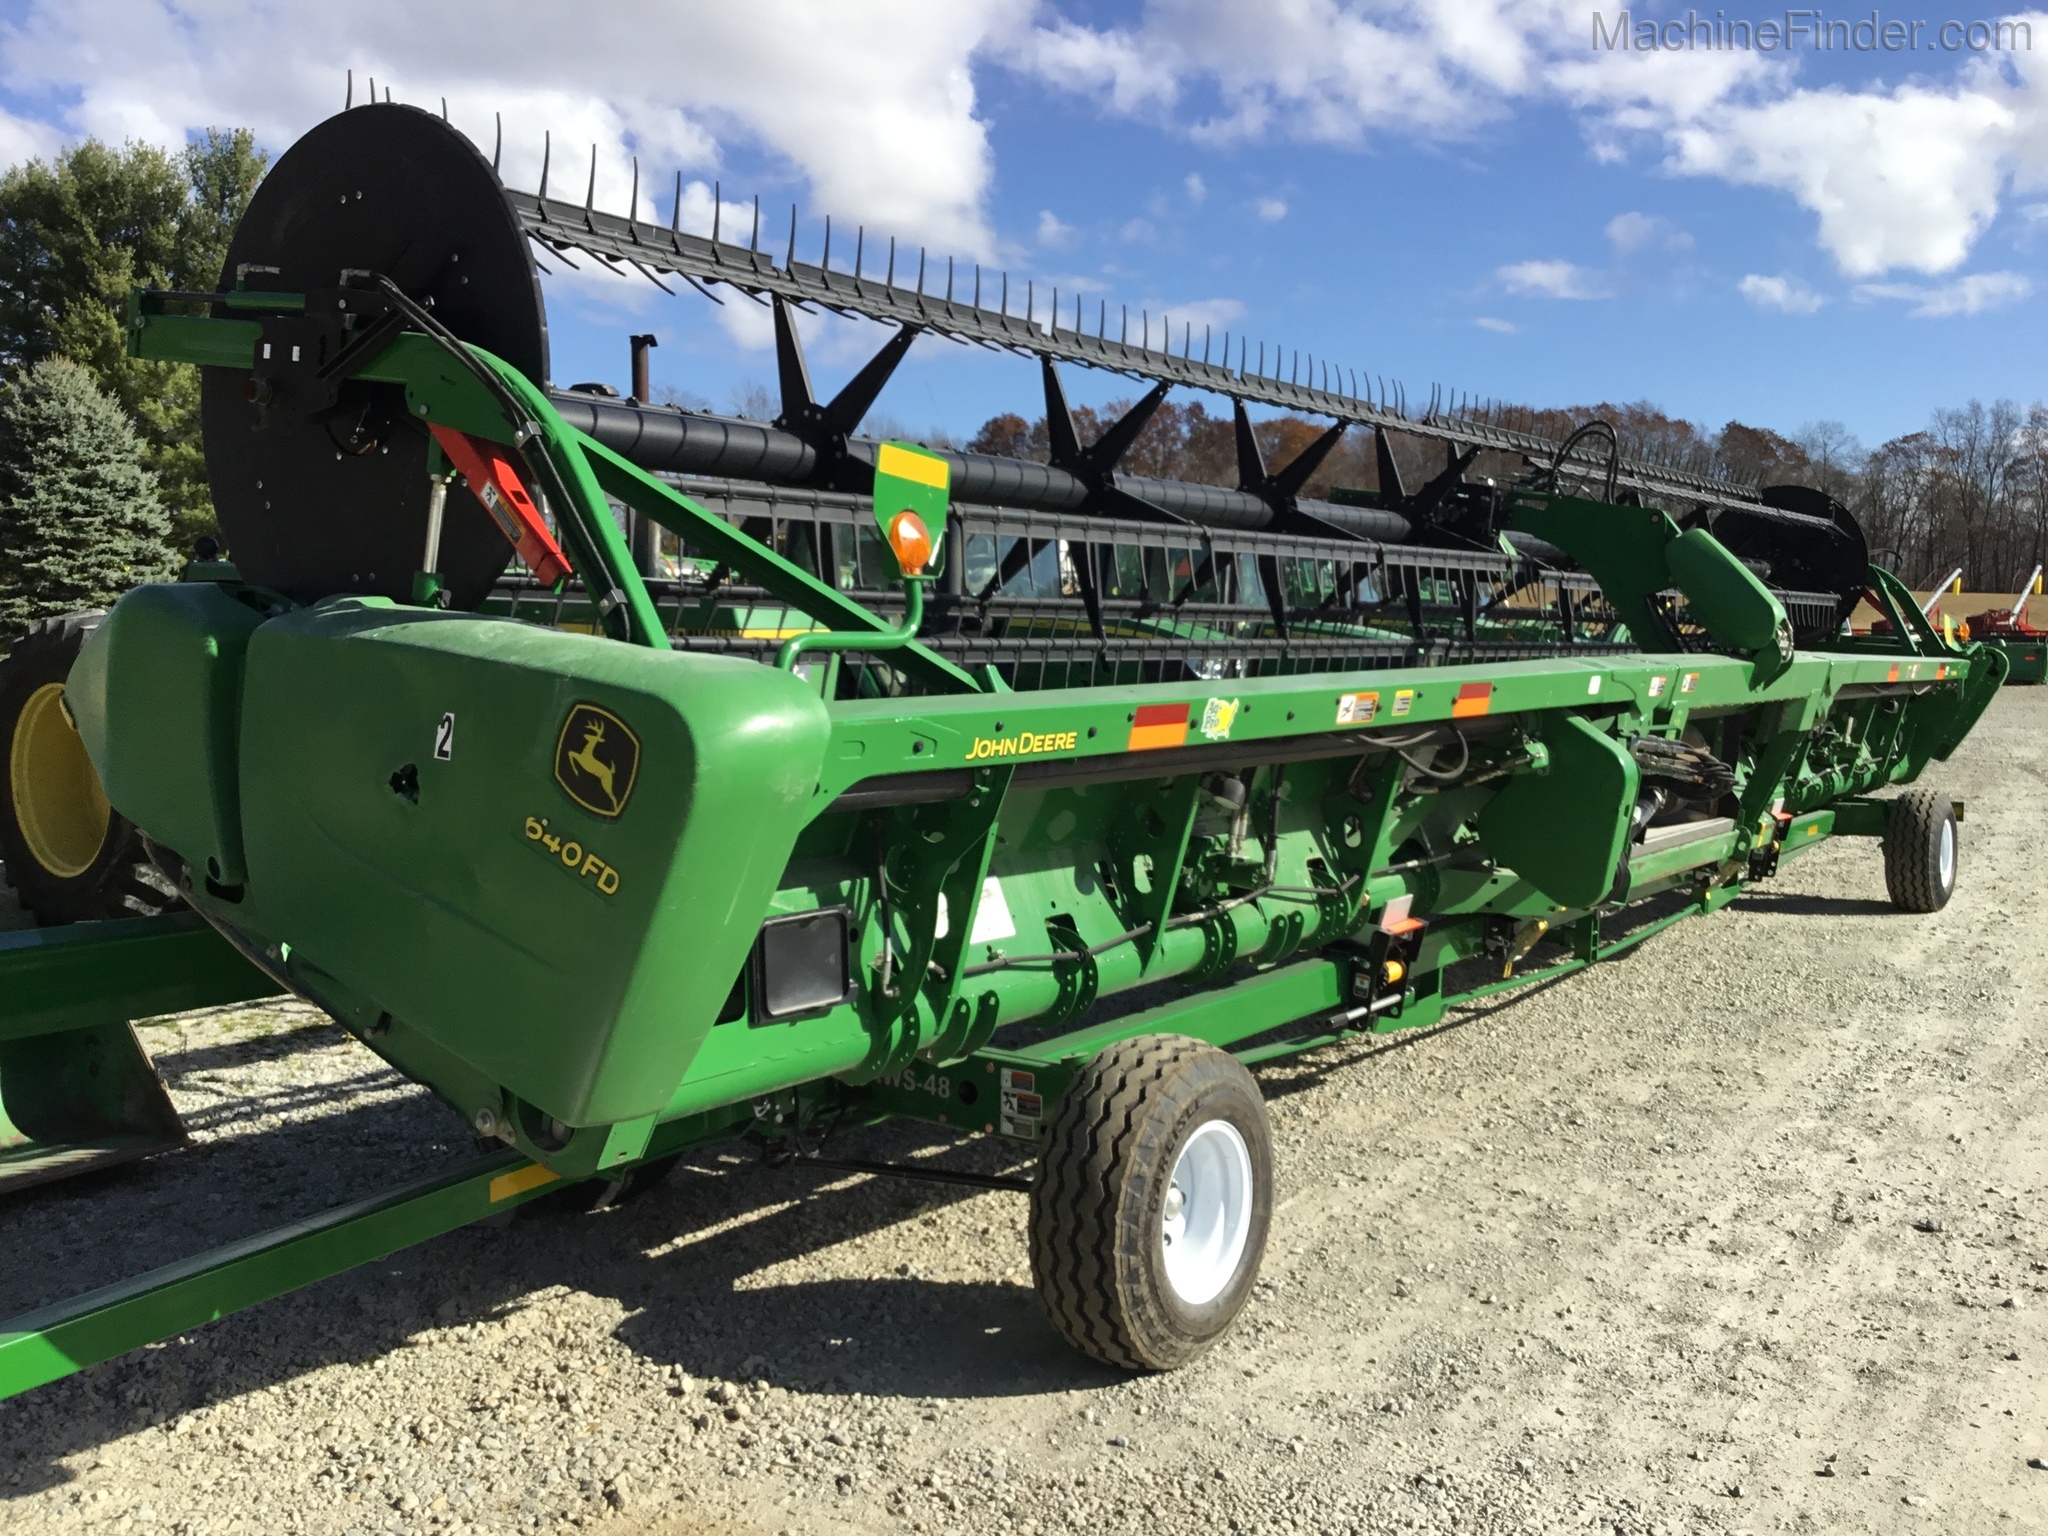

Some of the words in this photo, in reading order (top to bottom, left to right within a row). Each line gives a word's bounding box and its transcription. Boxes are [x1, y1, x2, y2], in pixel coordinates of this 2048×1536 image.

[436, 714, 453, 759] 2
[965, 736, 1018, 760] JOHN
[1018, 732, 1078, 754] DEERE
[525, 816, 620, 895] 640FD
[876, 1069, 950, 1098] WS-48
